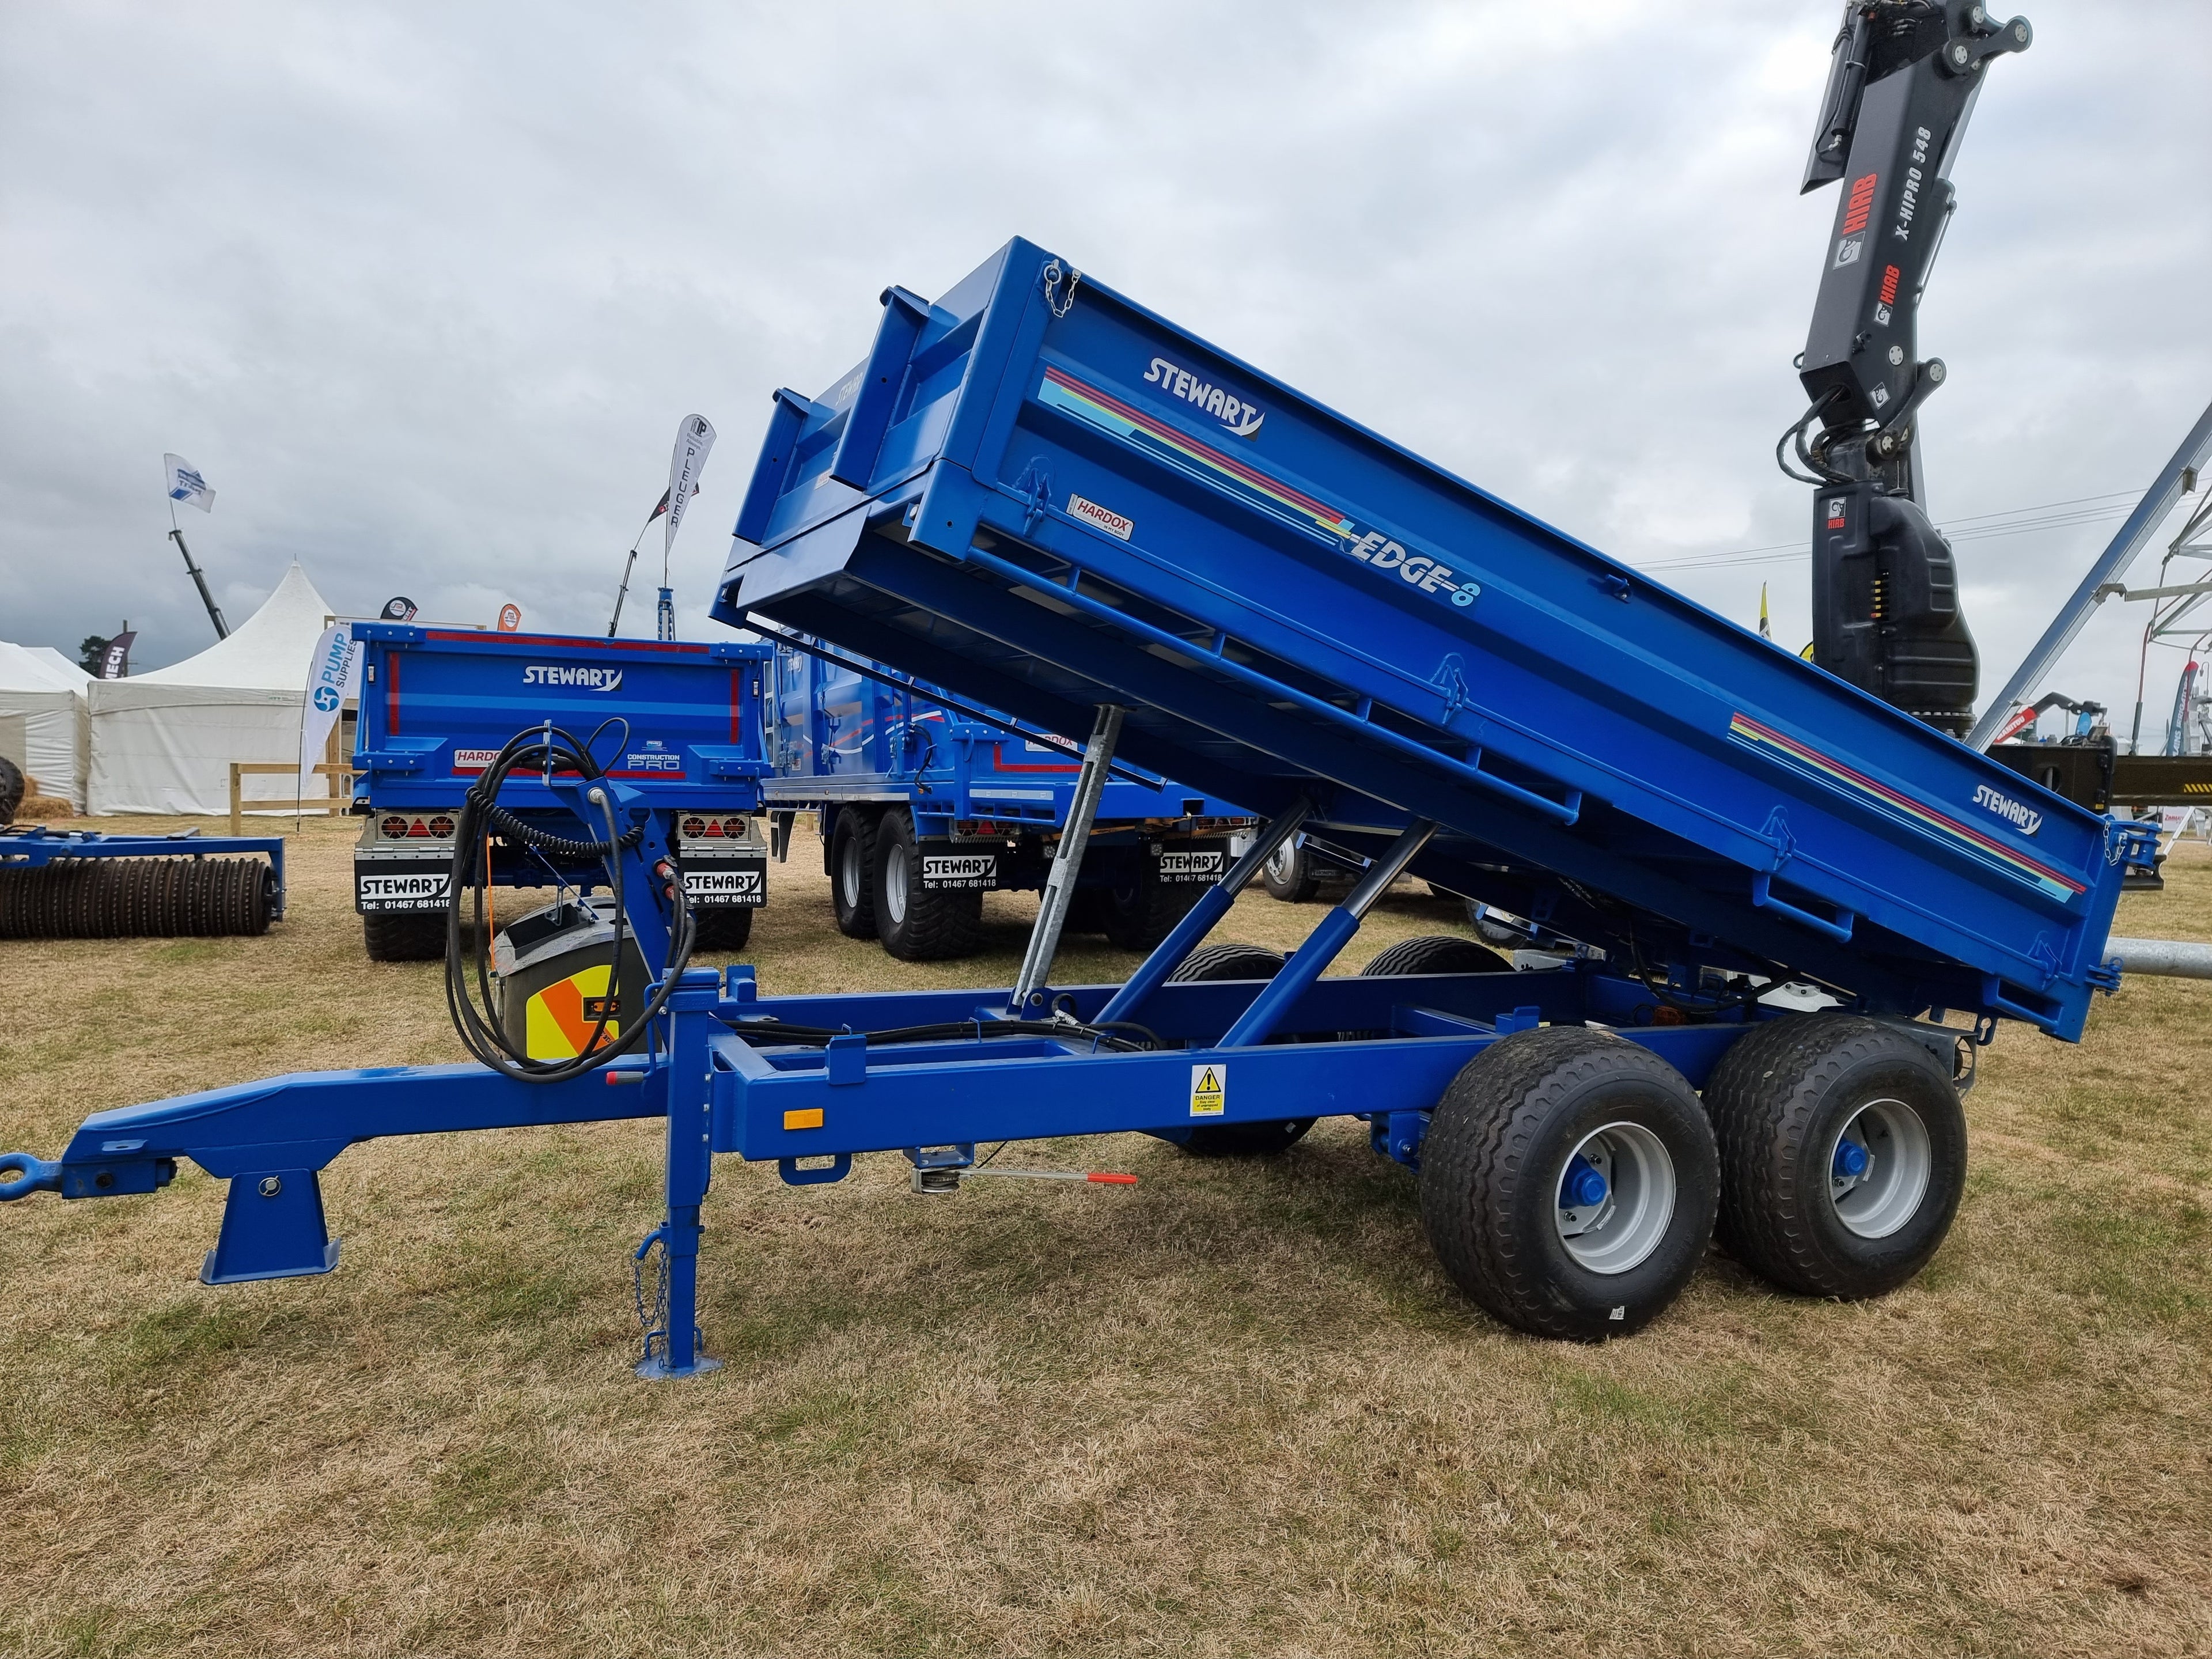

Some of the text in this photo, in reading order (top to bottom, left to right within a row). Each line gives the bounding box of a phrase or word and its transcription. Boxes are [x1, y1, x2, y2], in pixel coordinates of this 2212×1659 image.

[1896, 126, 1932, 241] X-HIPRO 548
[1843, 173, 1877, 234] HIAB
[1880, 264, 1900, 305] HIAB
[1143, 357, 1266, 436] STEWART
[1077, 501, 1129, 531] HARDOX
[1828, 518, 1844, 529] HIAB
[321, 632, 347, 684] PUMP
[336, 638, 357, 688] SUPPLIES
[523, 666, 622, 691] STEWART
[628, 760, 680, 770] PRO
[1972, 785, 2043, 835] STEWART
[923, 857, 997, 877] STEWART
[1160, 855, 1223, 873] STEWART
[361, 876, 451, 899] STEWART
[685, 873, 761, 893] STEWART
[968, 879, 996, 887] 681418
[361, 902, 379, 910] Tel:
[385, 900, 414, 909] 01467
[704, 895, 729, 903] 01467
